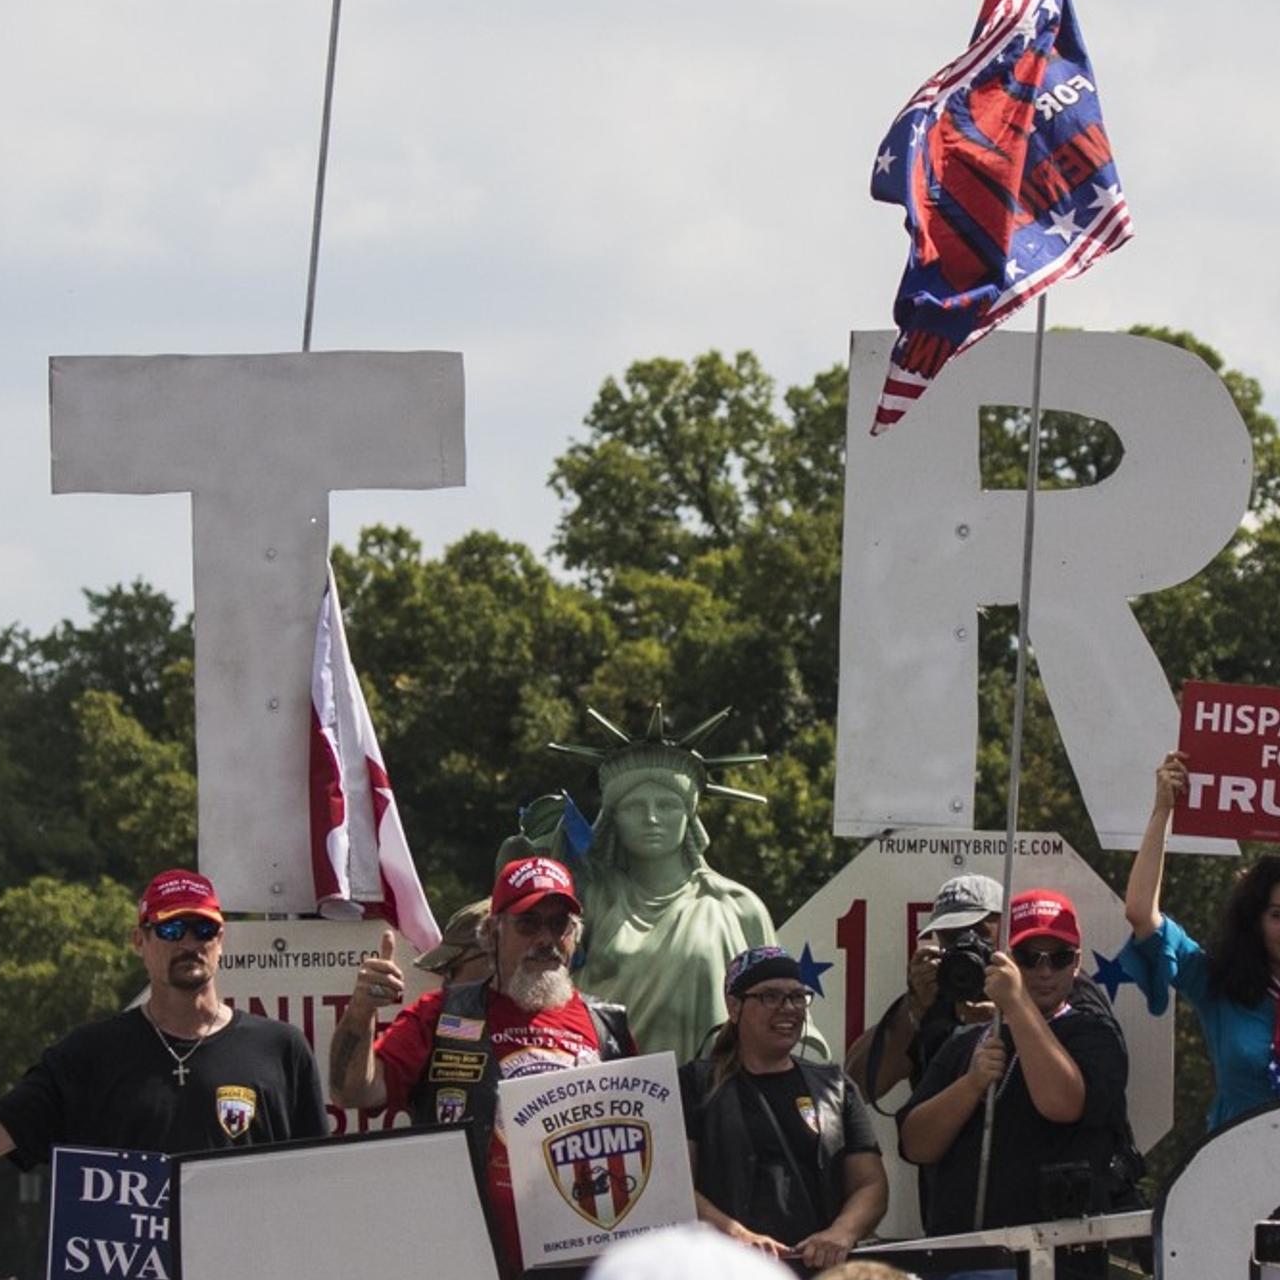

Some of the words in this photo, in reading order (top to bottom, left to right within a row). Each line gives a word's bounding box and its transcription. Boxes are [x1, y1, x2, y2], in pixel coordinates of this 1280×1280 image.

[219, 950, 381, 969] RUMPUNITYBRIDGE.C
[513, 1079, 595, 1127] MINNESOTA
[599, 1077, 670, 1102] CHAPTER
[541, 1101, 605, 1134] BIKERS
[610, 1100, 644, 1118] FOR
[551, 1127, 643, 1164] TRUMP
[80, 1167, 170, 1209] DRA
[130, 1213, 170, 1241] TH
[543, 1236, 585, 1253] BIKERS
[587, 1231, 611, 1245] FOR
[64, 1236, 170, 1280] SWA
